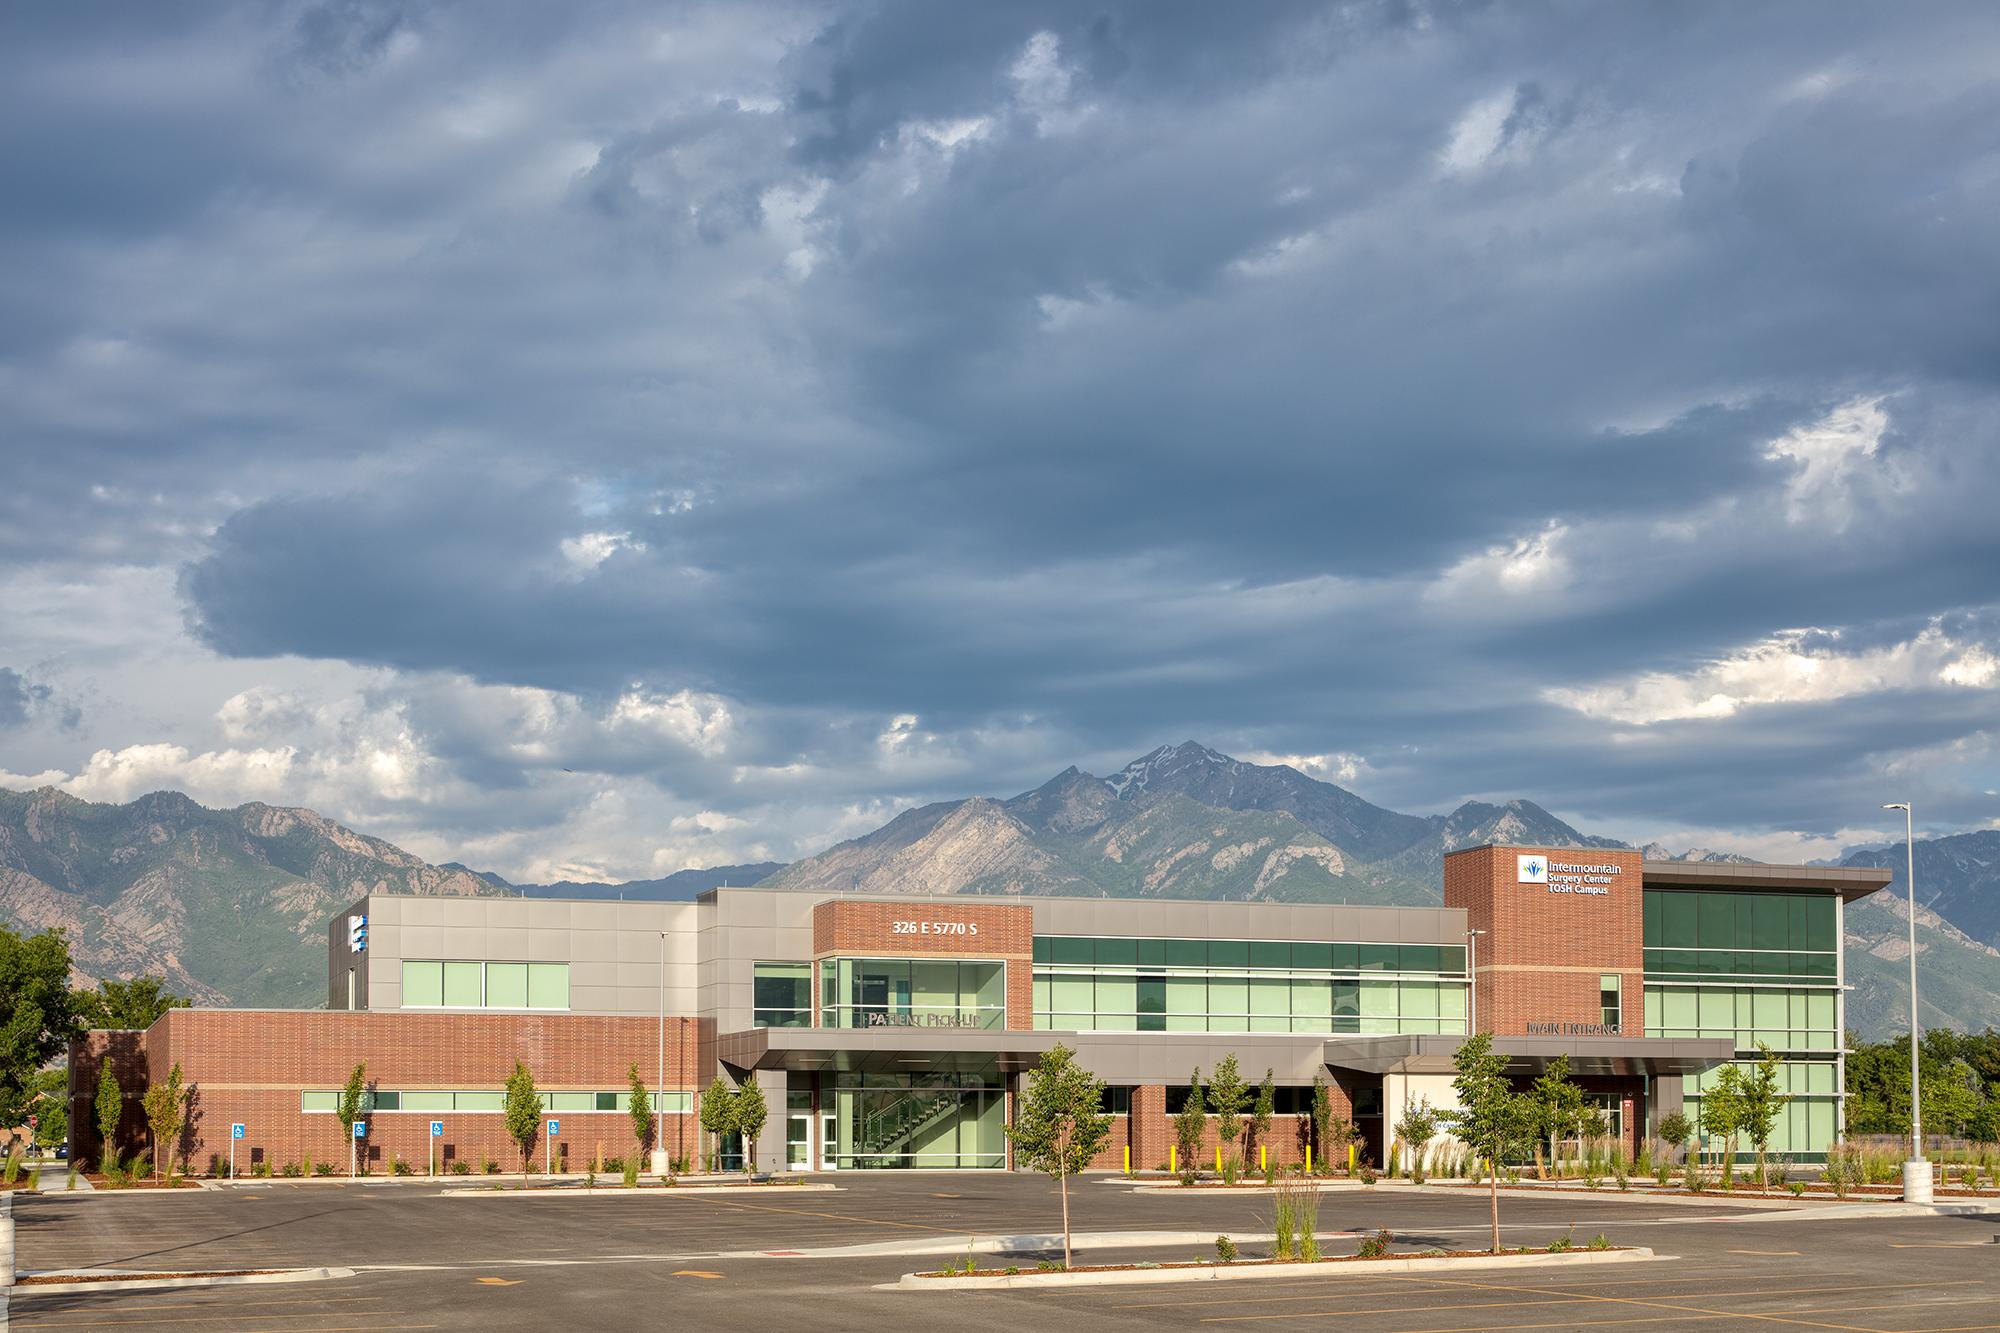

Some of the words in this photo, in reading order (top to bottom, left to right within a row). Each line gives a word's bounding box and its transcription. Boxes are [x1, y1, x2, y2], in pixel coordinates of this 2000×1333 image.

[1549, 861, 1622, 874] Intermountain
[1548, 873, 1582, 885] Surgery
[1584, 875, 1613, 884] Center
[1548, 883, 1573, 893] TOSH
[1574, 885, 1608, 895] Campus
[892, 921, 918, 934] 326
[921, 922, 930, 934] E
[933, 922, 966, 935] 5770
[969, 923, 978, 935] S
[868, 1012, 924, 1026] PATIENT
[927, 1013, 981, 1028] PICK-UP
[1526, 1022, 1560, 1035] MAIN
[1563, 1022, 1623, 1036] ENTRANCE
